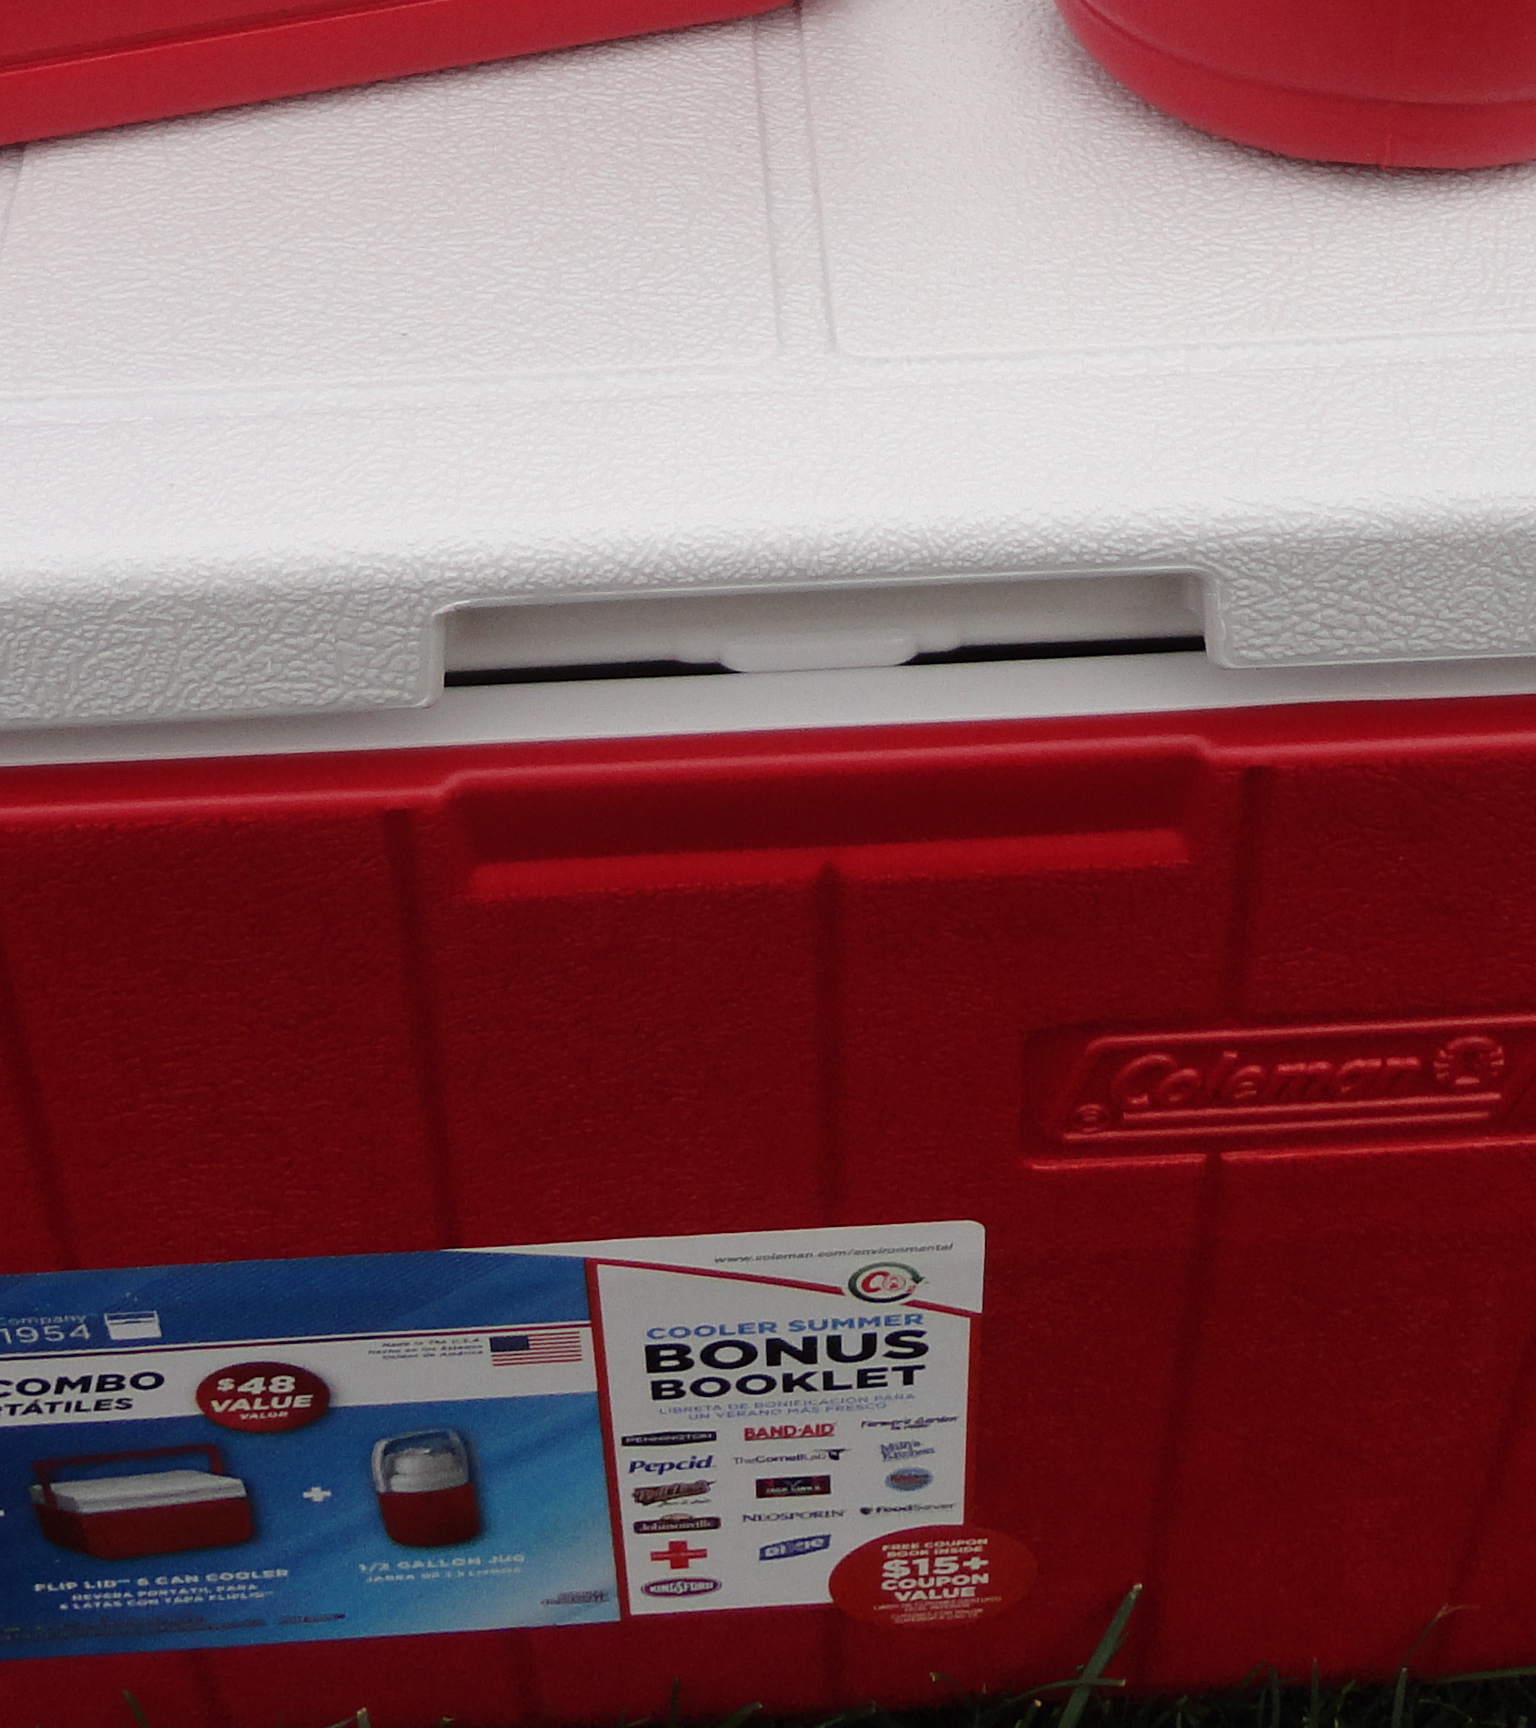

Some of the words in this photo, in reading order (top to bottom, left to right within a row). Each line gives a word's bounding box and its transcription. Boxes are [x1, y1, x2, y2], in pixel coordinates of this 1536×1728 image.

[1112, 1049, 1421, 1105] Coleman
[646, 1322, 778, 1341] COOLER
[788, 1313, 924, 1333] SUMMER
[645, 1329, 930, 1375] BONUS
[217, 1375, 296, 1395] $48
[650, 1364, 926, 1401] BOOKLET
[210, 1393, 314, 1413] VALUE
[659, 1403, 723, 1416] LIBRETA
[728, 1402, 748, 1412] DE
[688, 1410, 710, 1420] UN
[715, 1407, 783, 1421] VERANO
[825, 1401, 887, 1414] FRESCO
[239, 1410, 289, 1420] VALOR
[744, 1423, 836, 1440] BAND-AID
[628, 1455, 714, 1475] Pepcid
[743, 1509, 845, 1522] NEOSPORIN
[882, 1542, 920, 1552] FREE
[924, 1538, 988, 1549] COUPON
[887, 1548, 930, 1558] BOOK
[934, 1545, 983, 1556] INSIDE
[397, 1556, 482, 1570] GALLON
[488, 1553, 526, 1565] JUG
[882, 1556, 989, 1579] $15+
[34, 1582, 78, 1592] FLIP
[137, 1576, 149, 1586] 6
[155, 1574, 199, 1585] CAN
[205, 1569, 289, 1582] COOLER
[881, 1573, 989, 1590] COUPON
[895, 1586, 976, 1602] VALUE
